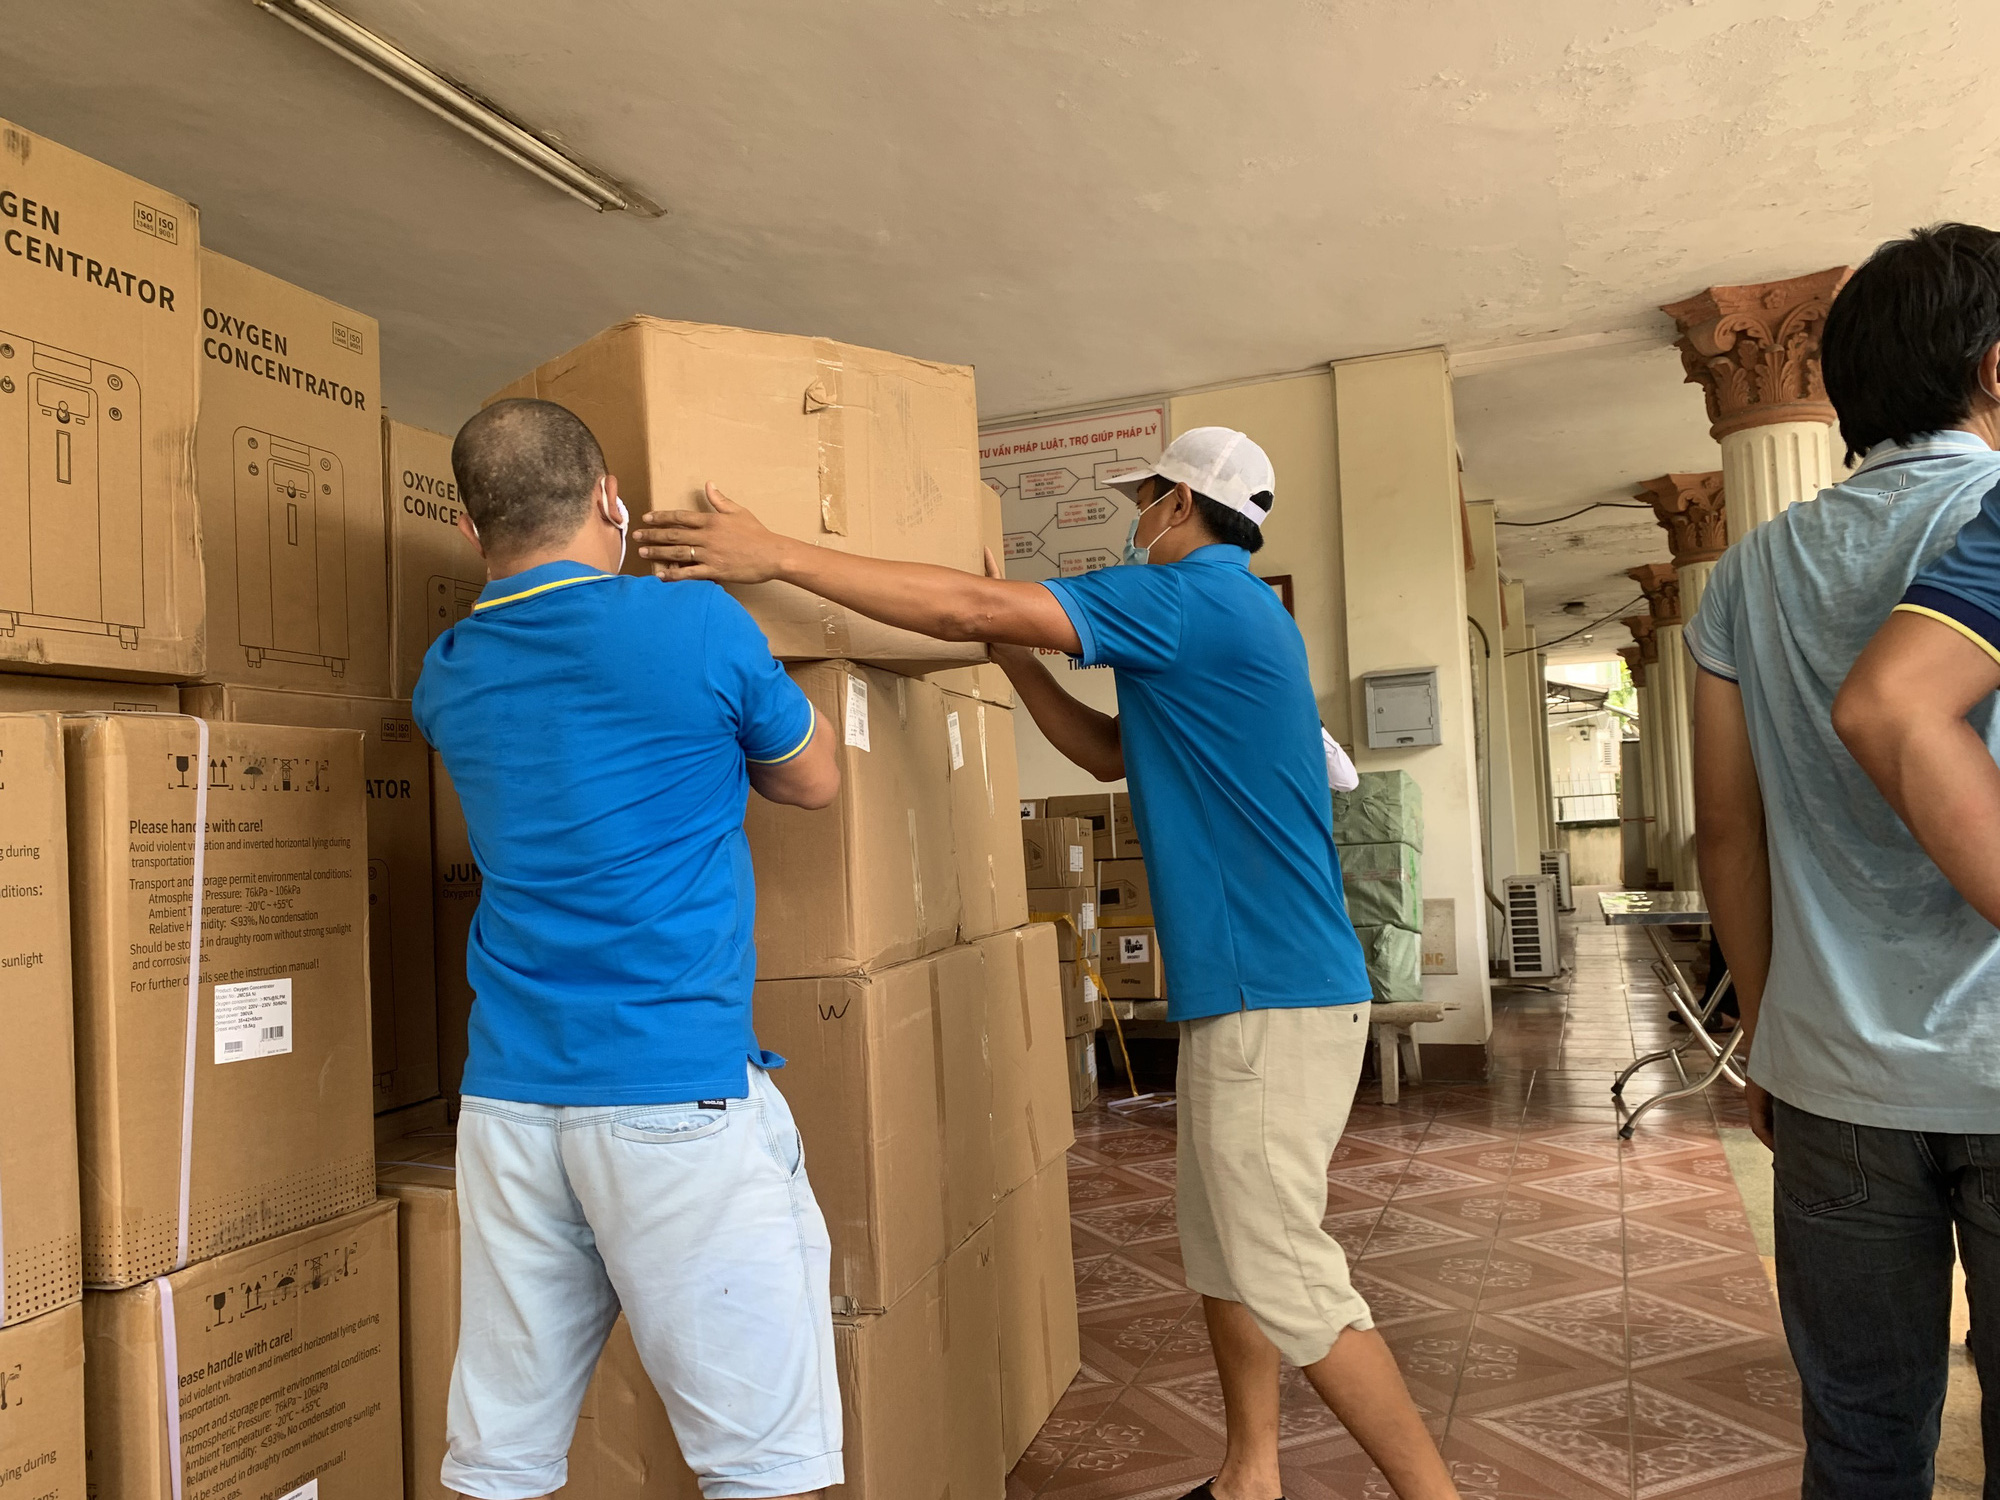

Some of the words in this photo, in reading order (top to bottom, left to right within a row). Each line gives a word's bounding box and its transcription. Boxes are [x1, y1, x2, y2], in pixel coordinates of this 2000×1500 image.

[138, 208, 152, 222] ISO
[158, 218, 174, 230] ISO
[158, 228, 174, 238] 9001
[4, 229, 175, 312] CENTRATOR
[203, 307, 287, 356] OXYGEN
[334, 327, 346, 338] ISO
[350, 333, 360, 344] ISO
[203, 337, 366, 411] CONCENTRATOR
[993, 443, 1011, 457] VẤN
[1013, 441, 1038, 454] PHÁP
[1041, 437, 1067, 451] LUẬT,
[1069, 433, 1088, 446] TRỢ
[1091, 430, 1114, 443] GIÚP
[1116, 426, 1142, 440] PHÁP
[1145, 422, 1158, 436] LÝ
[404, 496, 463, 526] CONCE
[384, 722, 394, 730] ISO
[398, 724, 409, 732] ISO
[129, 819, 168, 834] Please
[212, 819, 236, 832] with
[238, 819, 263, 832] care!
[6, 844, 40, 860] during
[129, 841, 154, 852] Avoid
[156, 840, 186, 852] violent
[188, 840, 224, 851] viation
[226, 839, 240, 850] and
[243, 838, 274, 849] inverted
[276, 837, 311, 848] horizontal
[312, 836, 328, 850] lying
[330, 836, 351, 849] during
[0, 884, 42, 898] ditions:
[129, 877, 175, 891] Transport
[177, 874, 194, 888] and
[202, 875, 228, 888] orage
[230, 872, 256, 887] permit
[258, 870, 312, 883] environmental
[313, 868, 352, 880] conditions:
[206, 890, 242, 900] Pressure:
[246, 887, 268, 898] 76kPa
[276, 885, 300, 896] 106kPa
[148, 908, 187, 920] Ambient
[149, 922, 184, 934] Relative
[258, 914, 269, 924] No
[270, 911, 318, 924] condensation
[130, 941, 162, 956] Should
[164, 941, 176, 952] be
[206, 937, 214, 947] in
[216, 933, 251, 948] draughty
[252, 932, 272, 942] room
[274, 929, 302, 940] without
[303, 927, 324, 938] strong
[326, 922, 352, 936] sunlight
[2, 952, 43, 968] sunlight
[132, 958, 150, 970] and
[152, 954, 191, 968] corrosive
[130, 982, 147, 992] For
[148, 976, 181, 990] further
[214, 972, 228, 982] see
[230, 968, 244, 980] the
[246, 964, 288, 978] instruction
[288, 958, 320, 972] manual!
[178, 1368, 205, 1390] lease
[207, 1350, 244, 1376] handle
[245, 1339, 268, 1360] with
[270, 1328, 293, 1350] care!
[194, 1382, 222, 1400] violent
[222, 1366, 257, 1387] vibration
[258, 1356, 272, 1373] and
[273, 1342, 303, 1366] inverted
[304, 1328, 340, 1352] horizontal
[340, 1323, 356, 1338] lying
[358, 1314, 380, 1329] during
[212, 1412, 228, 1430] and
[229, 1400, 259, 1422] storage
[260, 1386, 286, 1409] permit
[286, 1360, 340, 1394] environmental
[341, 1344, 381, 1369] conditions:
[185, 1425, 236, 1458] Atmospheric
[238, 1409, 272, 1432] Pressure:
[274, 1397, 296, 1414] 76kPa
[304, 1382, 329, 1400] 106kPa
[186, 1465, 218, 1488] Relative
[220, 1445, 257, 1471] Humidity:
[288, 1425, 298, 1436] No
[298, 1401, 346, 1430] condensation
[186, 1448, 220, 1472] Ambient
[222, 1424, 272, 1454] Temperature:
[212, 1472, 237, 1495] stored
[238, 1470, 246, 1481] in
[247, 1452, 281, 1476] draughty
[282, 1442, 301, 1459] room
[302, 1427, 330, 1448] without
[330, 1416, 352, 1434] strong
[354, 1402, 381, 1423] sunlight
[24, 1450, 57, 1473] during
[274, 1469, 315, 1498] instruction
[316, 1450, 347, 1476] manual!
